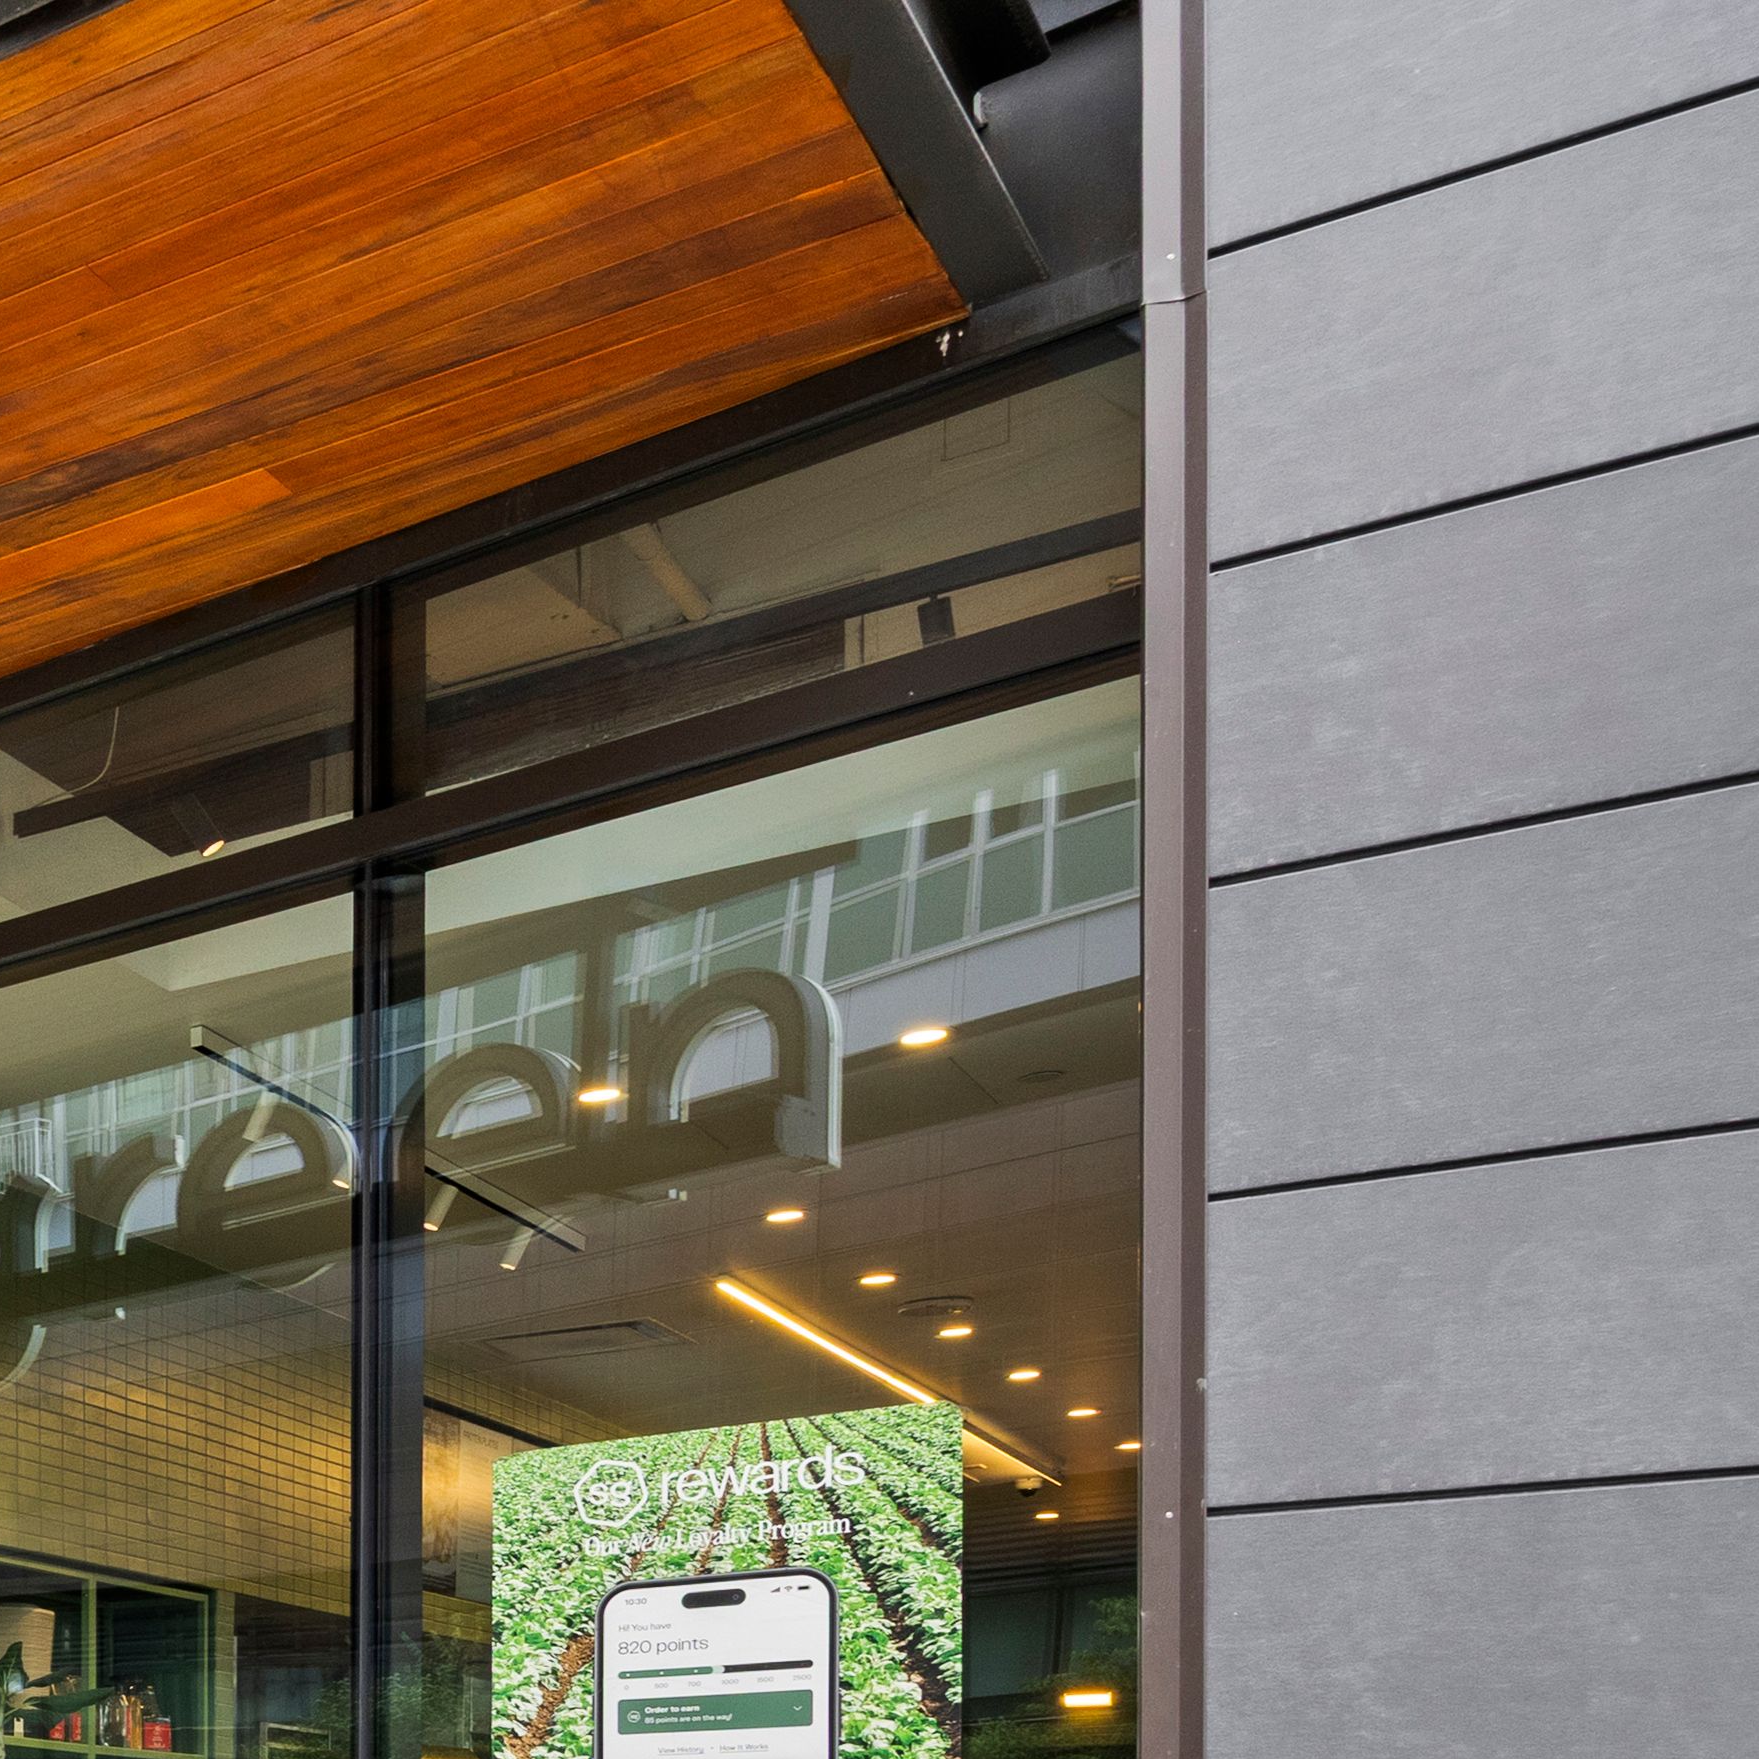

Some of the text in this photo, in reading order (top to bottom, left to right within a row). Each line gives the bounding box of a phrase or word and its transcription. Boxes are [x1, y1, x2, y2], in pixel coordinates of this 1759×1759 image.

[660, 1445, 866, 1501] rewards
[585, 1535, 628, 1557] Our
[675, 1521, 752, 1550] Loyalty
[758, 1517, 852, 1543] Program
[632, 1624, 649, 1632] You
[650, 1622, 672, 1631] have
[617, 1637, 709, 1655] 820 points
[644, 1706, 669, 1714] Order
[655, 1716, 678, 1724] points
